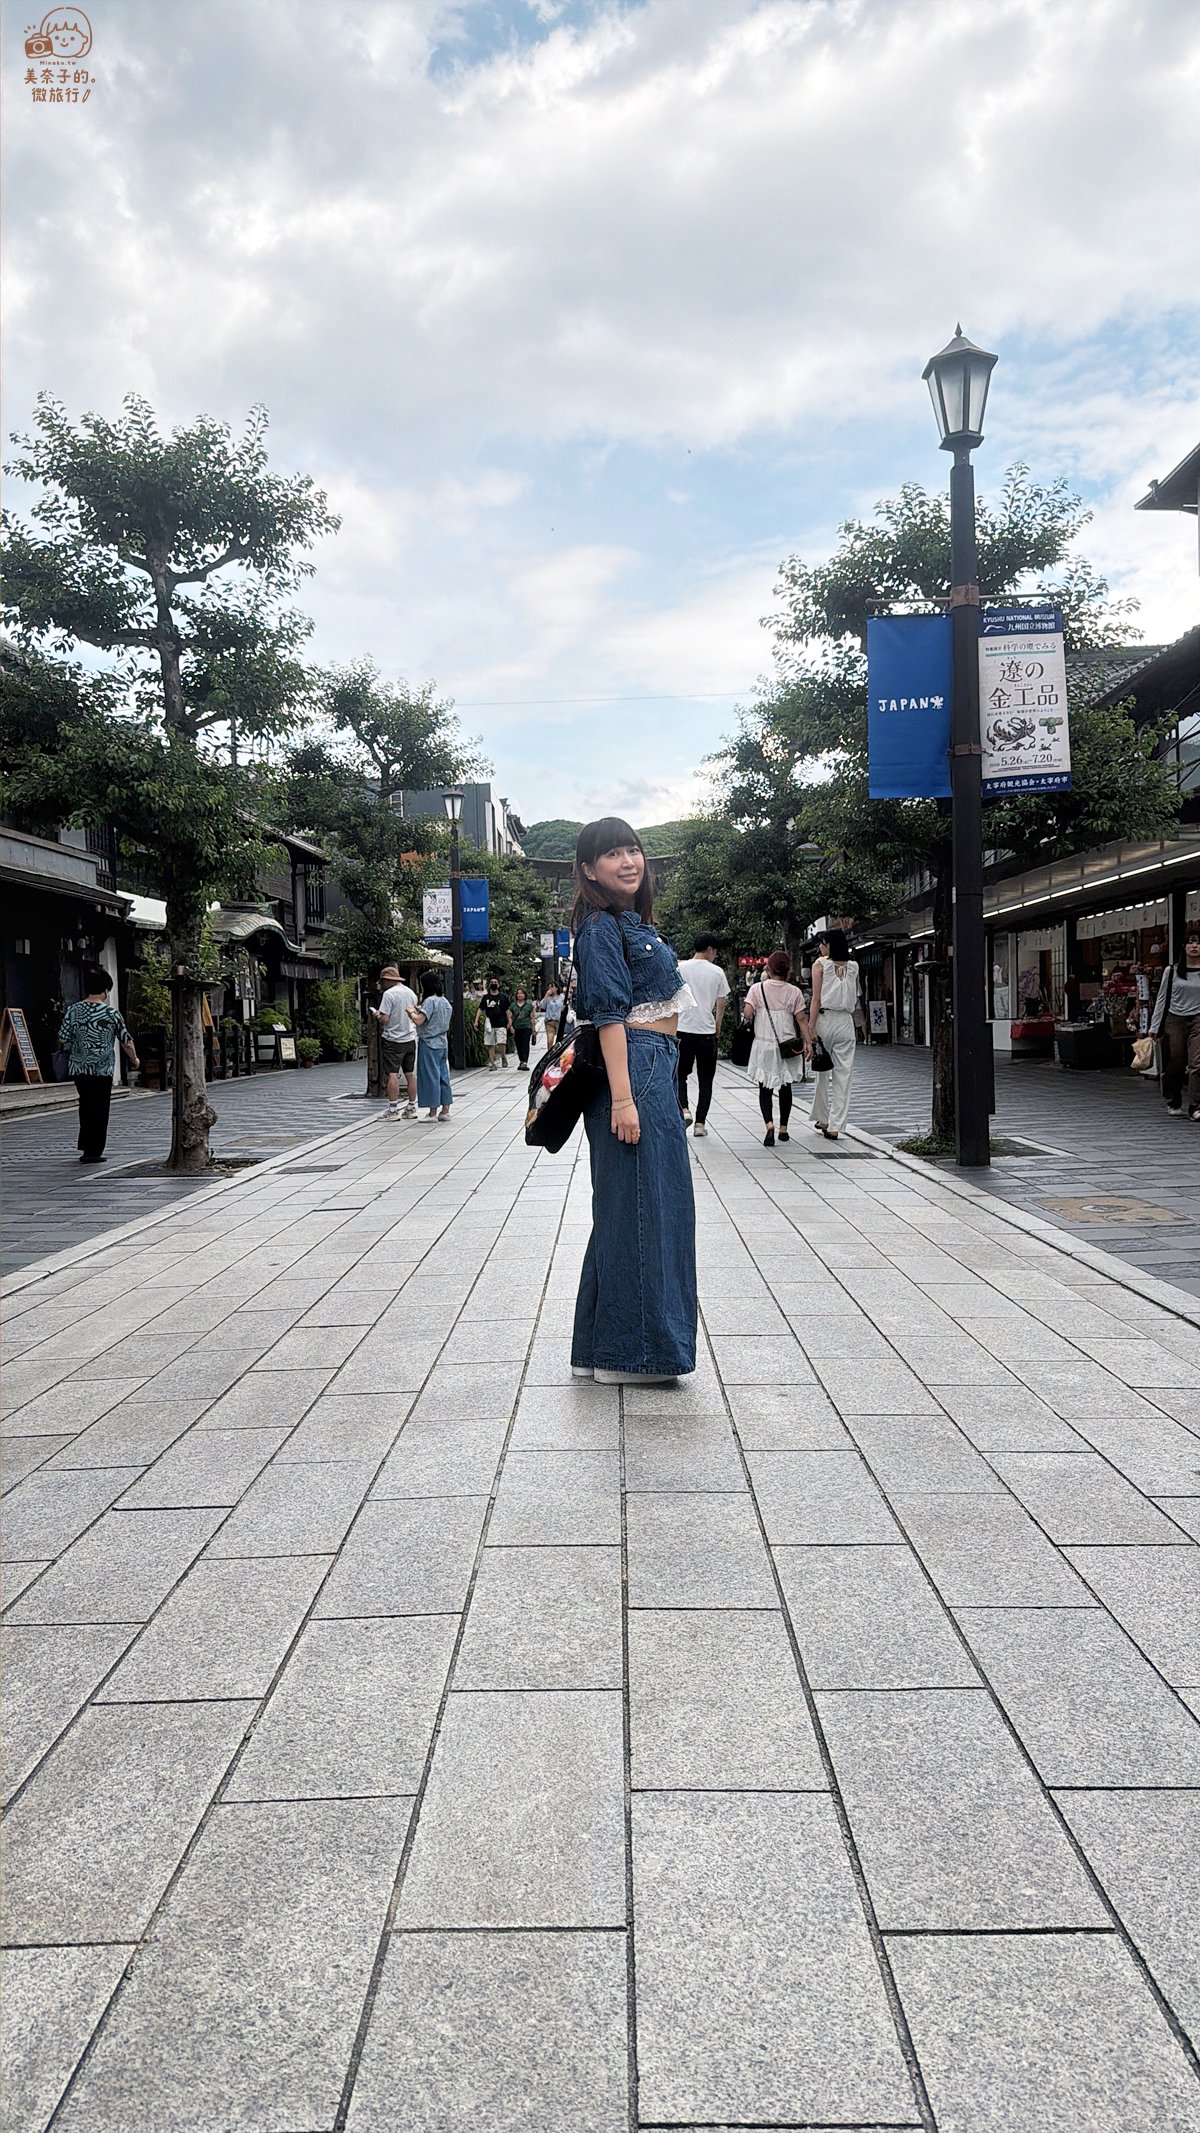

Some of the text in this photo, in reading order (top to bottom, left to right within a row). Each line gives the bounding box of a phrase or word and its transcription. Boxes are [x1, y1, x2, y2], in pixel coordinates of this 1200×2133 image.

[983, 615, 1005, 623] KYUSHU
[1008, 621, 1056, 631] 九州国立博物館
[999, 660, 1044, 683] 遼の
[988, 684, 1059, 710] 金工品
[878, 697, 929, 712] JAPAN
[1001, 755, 1023, 767] 5.26
[1032, 753, 1053, 764] 7.20
